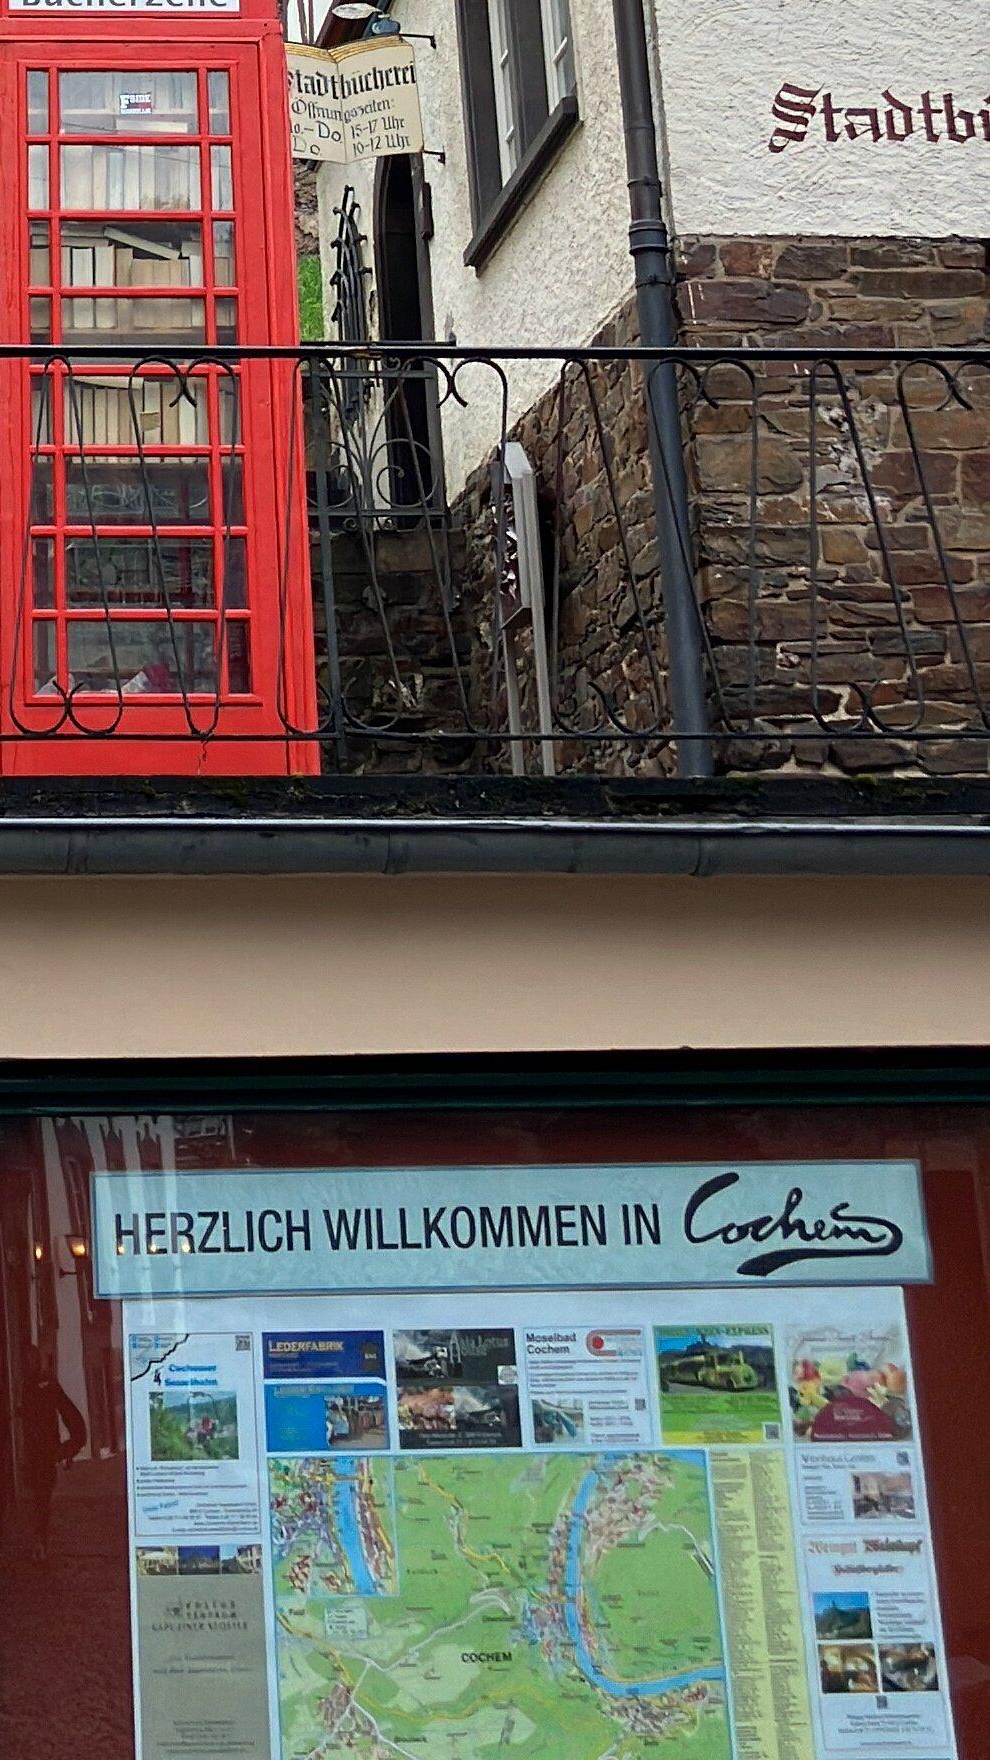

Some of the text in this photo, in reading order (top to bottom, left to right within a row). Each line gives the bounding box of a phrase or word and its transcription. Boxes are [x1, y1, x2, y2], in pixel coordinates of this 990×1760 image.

[115, 1171, 905, 1277] HERZLICH WILLKOMMEN IN Cochem
[526, 1332, 576, 1343] Moselbad
[526, 1344, 570, 1355] Cochem
[461, 1651, 513, 1663] COCHEM
